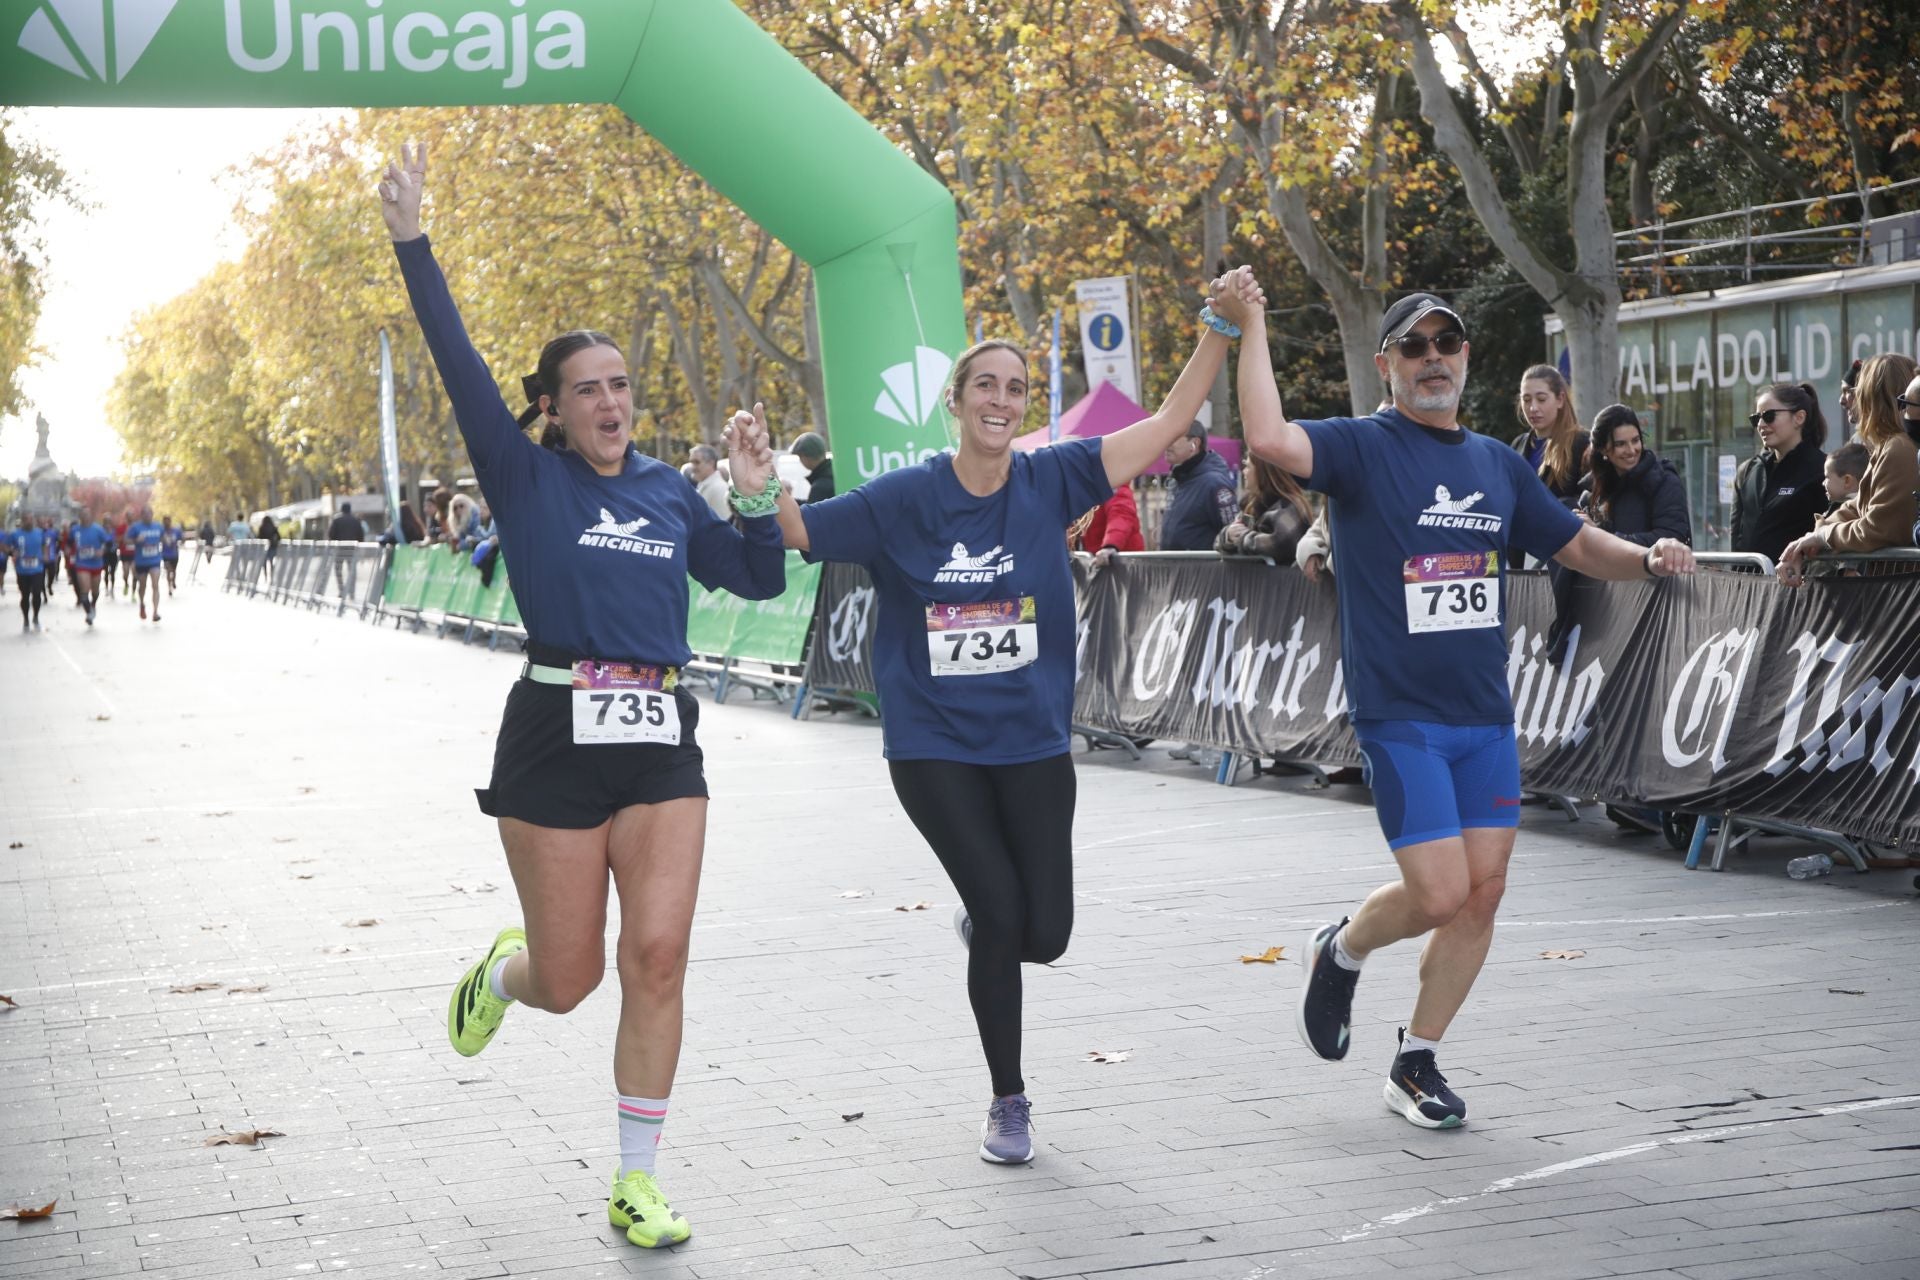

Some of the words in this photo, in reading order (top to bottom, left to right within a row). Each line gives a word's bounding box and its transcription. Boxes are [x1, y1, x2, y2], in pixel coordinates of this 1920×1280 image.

[223, 0, 586, 89] Unicaja
[856, 441, 958, 479] Unic
[1417, 514, 1502, 533] MICHELIN
[578, 534, 674, 559] MICHELIN
[933, 559, 1014, 583] MICHEIN
[1438, 561, 1473, 572] EMPRESAS
[962, 608, 1001, 620] EMPRESAS
[1421, 581, 1488, 616] 736
[943, 628, 1021, 662] 734
[1192, 596, 1321, 721] Norte
[589, 692, 665, 727] 735
[1763, 630, 1920, 784] Nor
